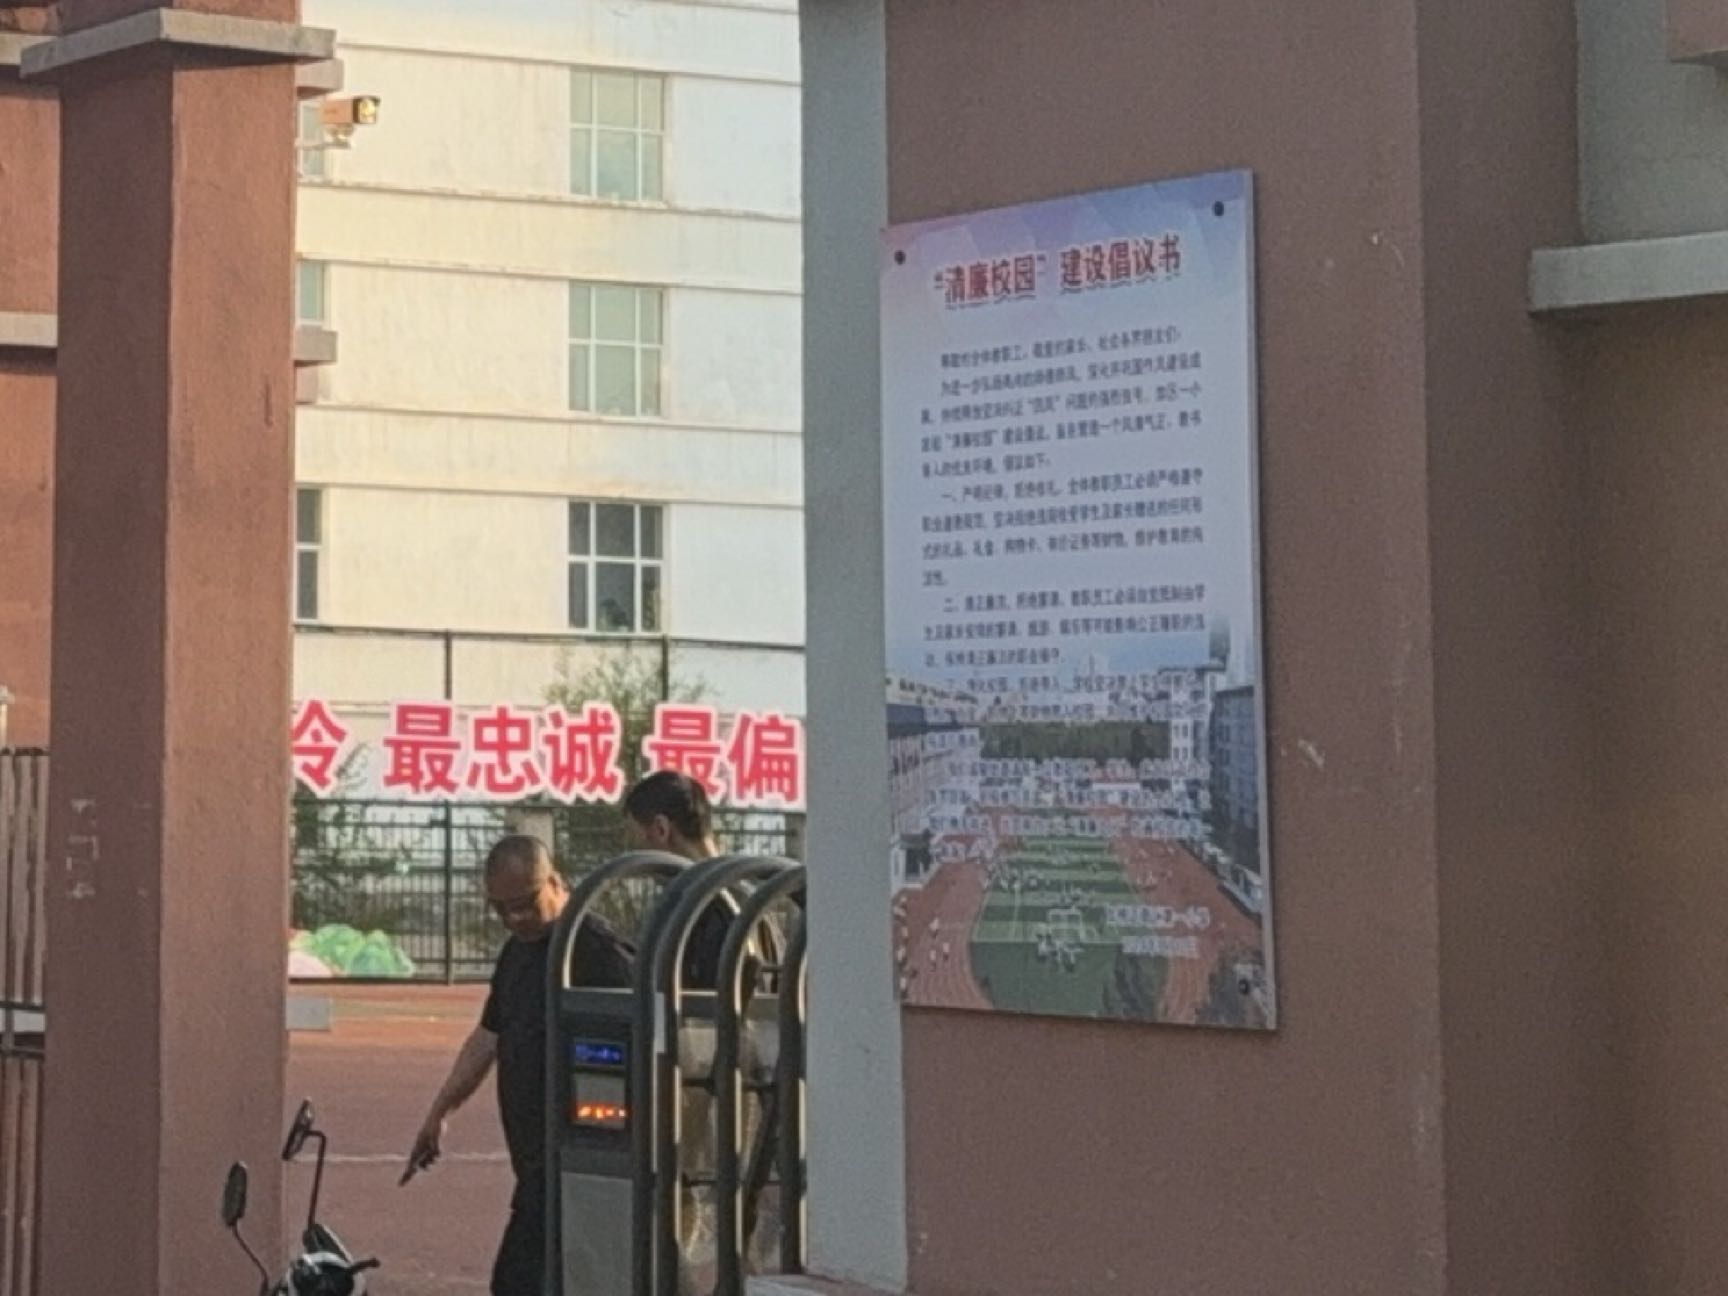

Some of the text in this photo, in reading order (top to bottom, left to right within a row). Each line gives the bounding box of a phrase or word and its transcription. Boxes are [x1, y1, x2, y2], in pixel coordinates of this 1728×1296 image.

[1062, 234, 1181, 287] 建设倡议书
[291, 700, 348, 791] 令
[383, 702, 622, 799] 最忠诚
